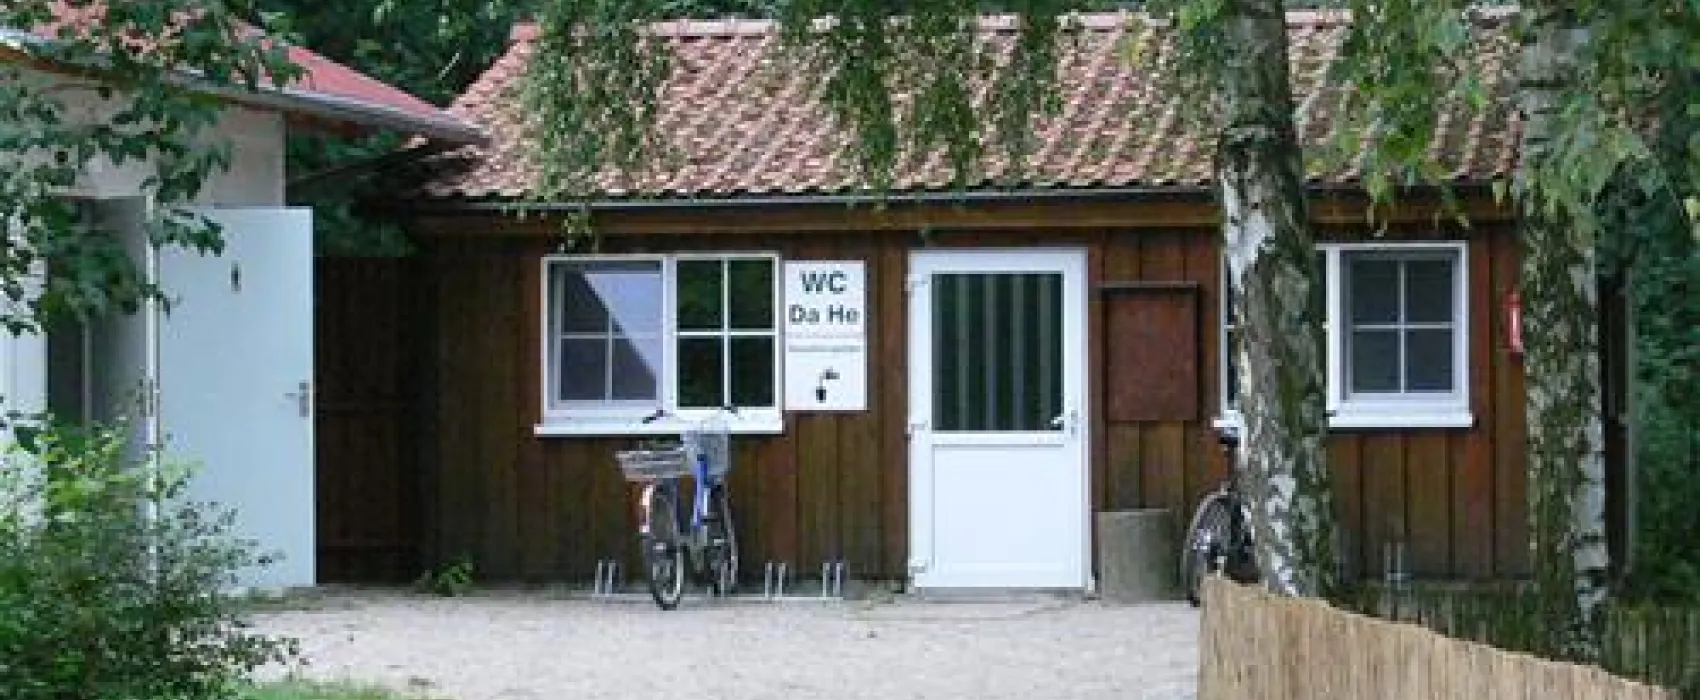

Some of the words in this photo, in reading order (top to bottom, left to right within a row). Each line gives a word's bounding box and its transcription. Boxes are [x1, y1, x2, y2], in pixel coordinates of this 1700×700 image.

[800, 271, 846, 294] WC
[789, 304, 820, 325] Da
[827, 304, 860, 325] He
